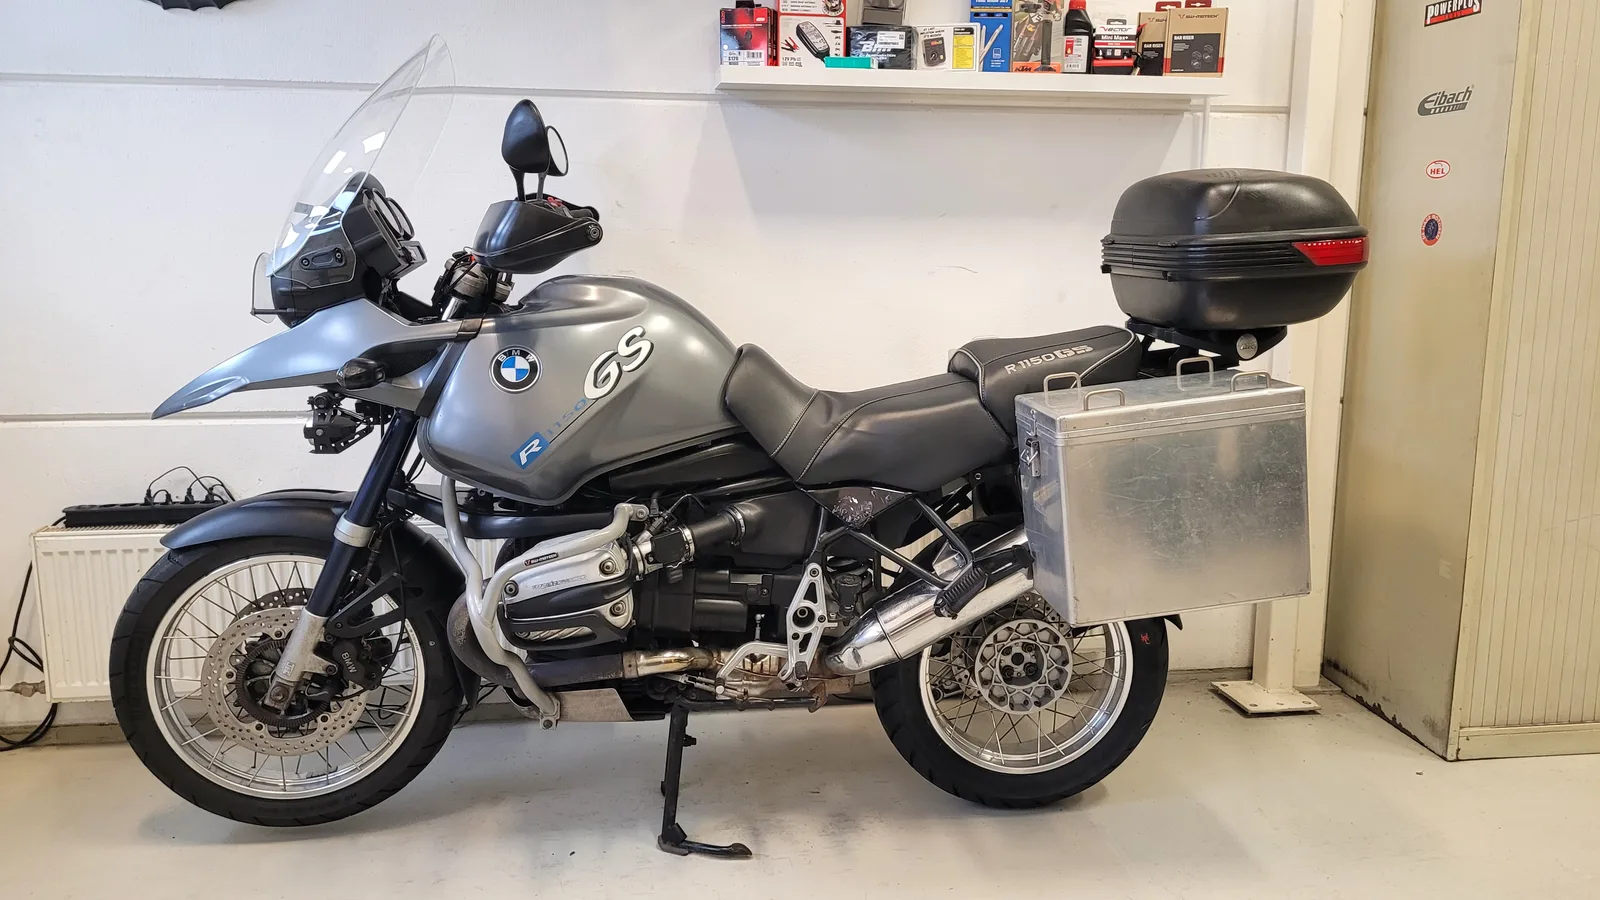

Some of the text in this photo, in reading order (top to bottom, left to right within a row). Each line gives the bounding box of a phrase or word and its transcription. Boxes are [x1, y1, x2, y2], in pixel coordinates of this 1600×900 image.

[1426, 0, 1480, 24] POWERPLUS
[1418, 86, 1472, 116] Eibach
[498, 349, 534, 363] BMW
[584, 325, 654, 400] GS
[1004, 363, 1018, 375] R
[519, 438, 542, 466] R
[341, 652, 357, 673] BMW
